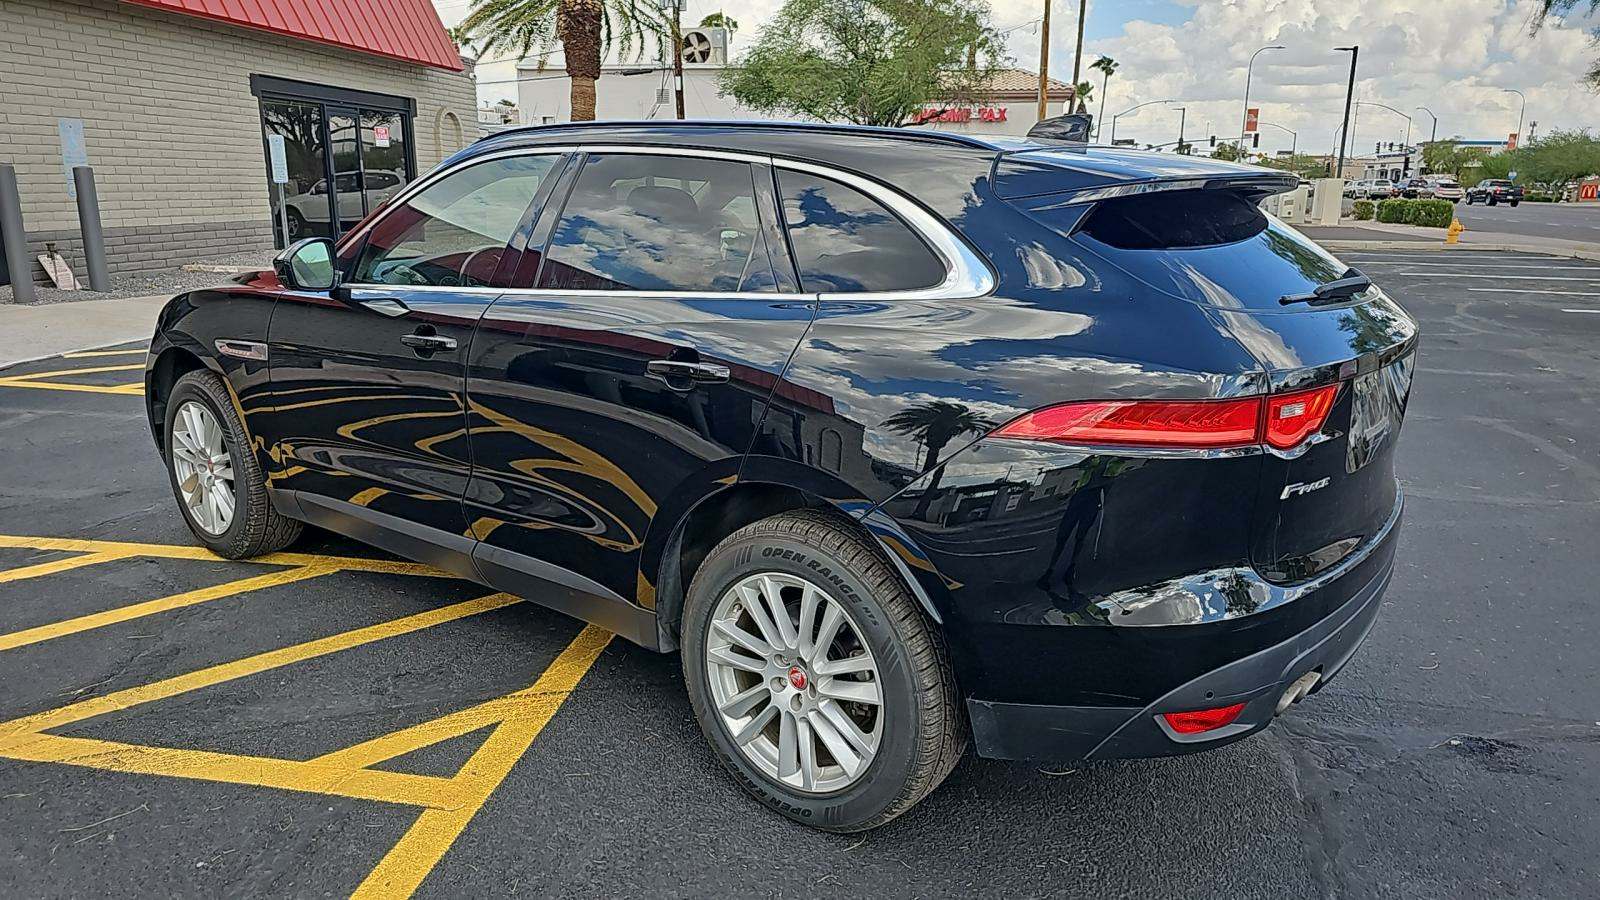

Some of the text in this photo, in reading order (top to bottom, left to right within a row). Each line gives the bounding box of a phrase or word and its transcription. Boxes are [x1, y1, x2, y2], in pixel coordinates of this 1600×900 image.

[978, 108, 1007, 122] TAX
[762, 547, 808, 563] OPEN
[807, 559, 862, 603] RANGE
[769, 797, 813, 817] OPEN
